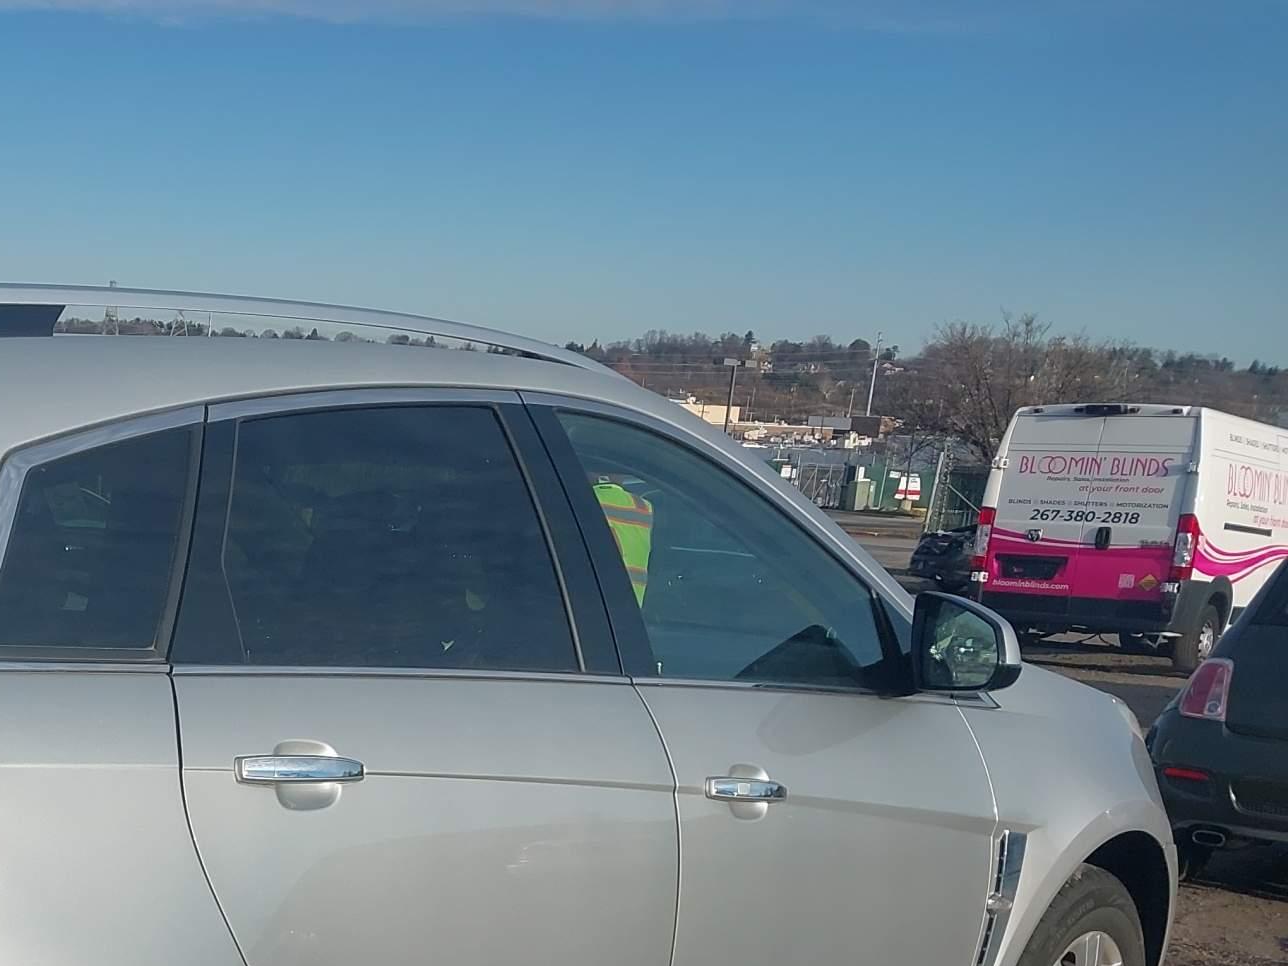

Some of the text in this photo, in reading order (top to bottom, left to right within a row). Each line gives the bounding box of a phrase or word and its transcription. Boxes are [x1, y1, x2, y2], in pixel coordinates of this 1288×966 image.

[1110, 457, 1175, 477] BLINDS
[1091, 486, 1113, 494] your
[1114, 485, 1140, 493] front
[1029, 509, 1140, 524] 267-380-2818
[992, 579, 1069, 591] bloominblinds.com
